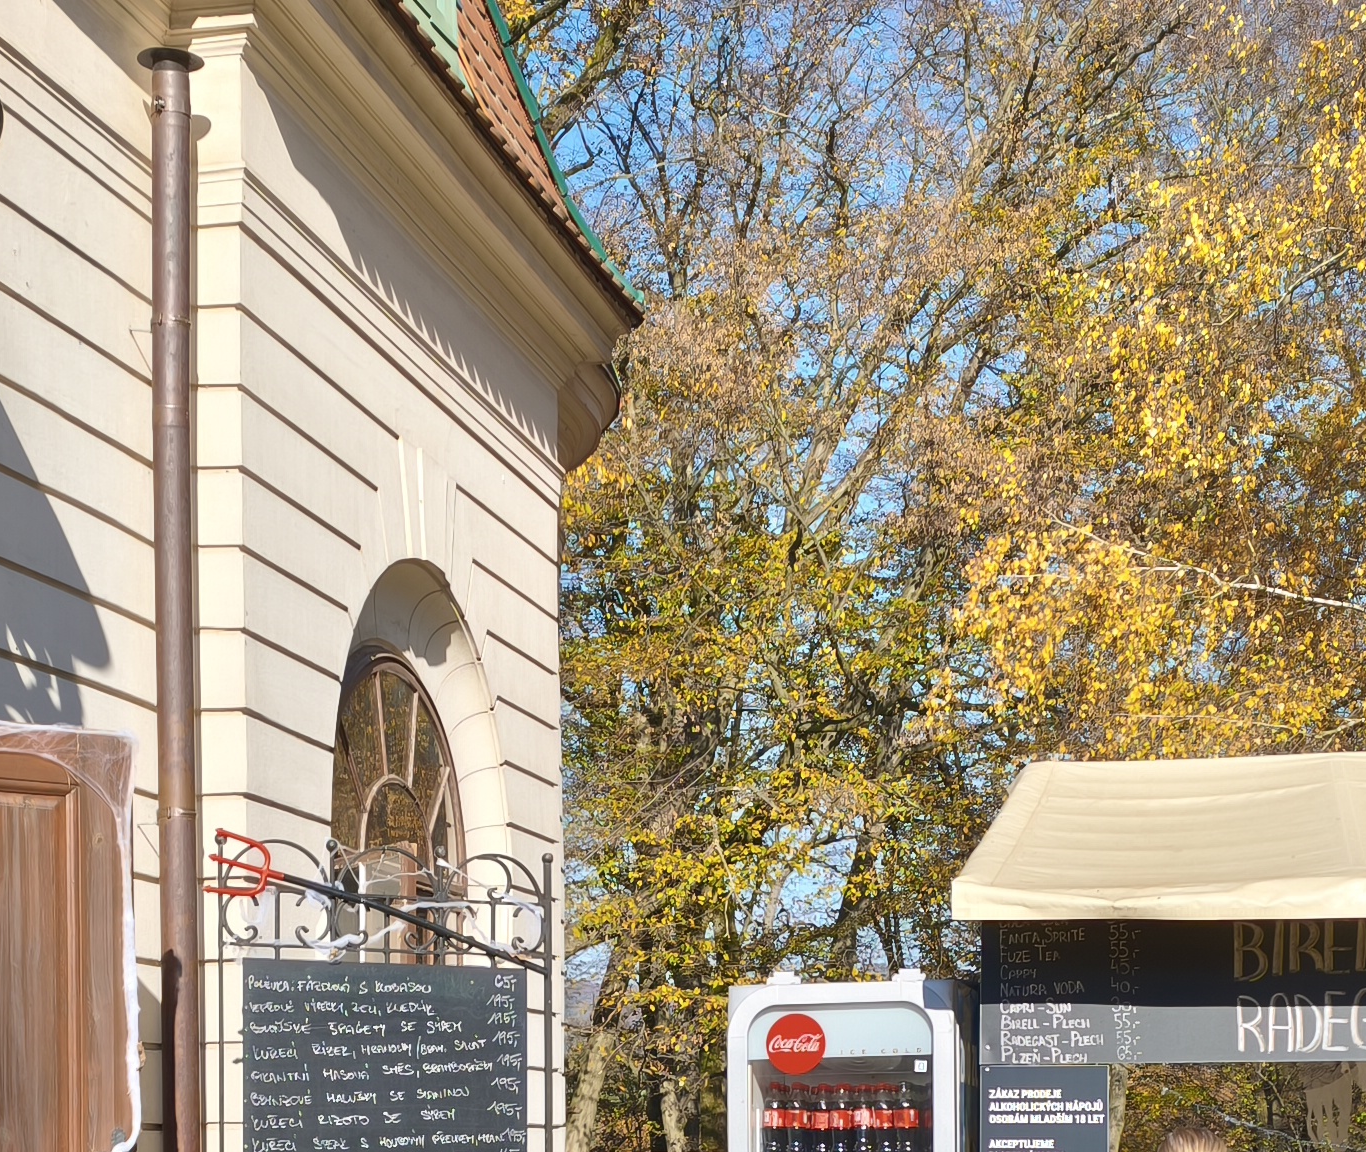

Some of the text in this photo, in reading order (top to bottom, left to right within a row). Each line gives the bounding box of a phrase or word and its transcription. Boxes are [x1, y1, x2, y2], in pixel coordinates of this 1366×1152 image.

[1054, 980, 1085, 996] VODA
[401, 1021, 416, 1032] SE
[769, 1033, 823, 1053] Coca-Cola
[390, 1091, 405, 1101] SE
[988, 1087, 1062, 1098] ZÁKAZ PRODEJE
[989, 1099, 1103, 1111] ALKOHOLICKÝCH NÁPOJŮ
[318, 1115, 369, 1126] RIZOTO
[989, 1112, 1105, 1123] OSOBÁM MLADŠÍM 18 LET
[361, 1138, 369, 1149] S
[988, 1139, 1055, 1149] AKCEPTUJEME
